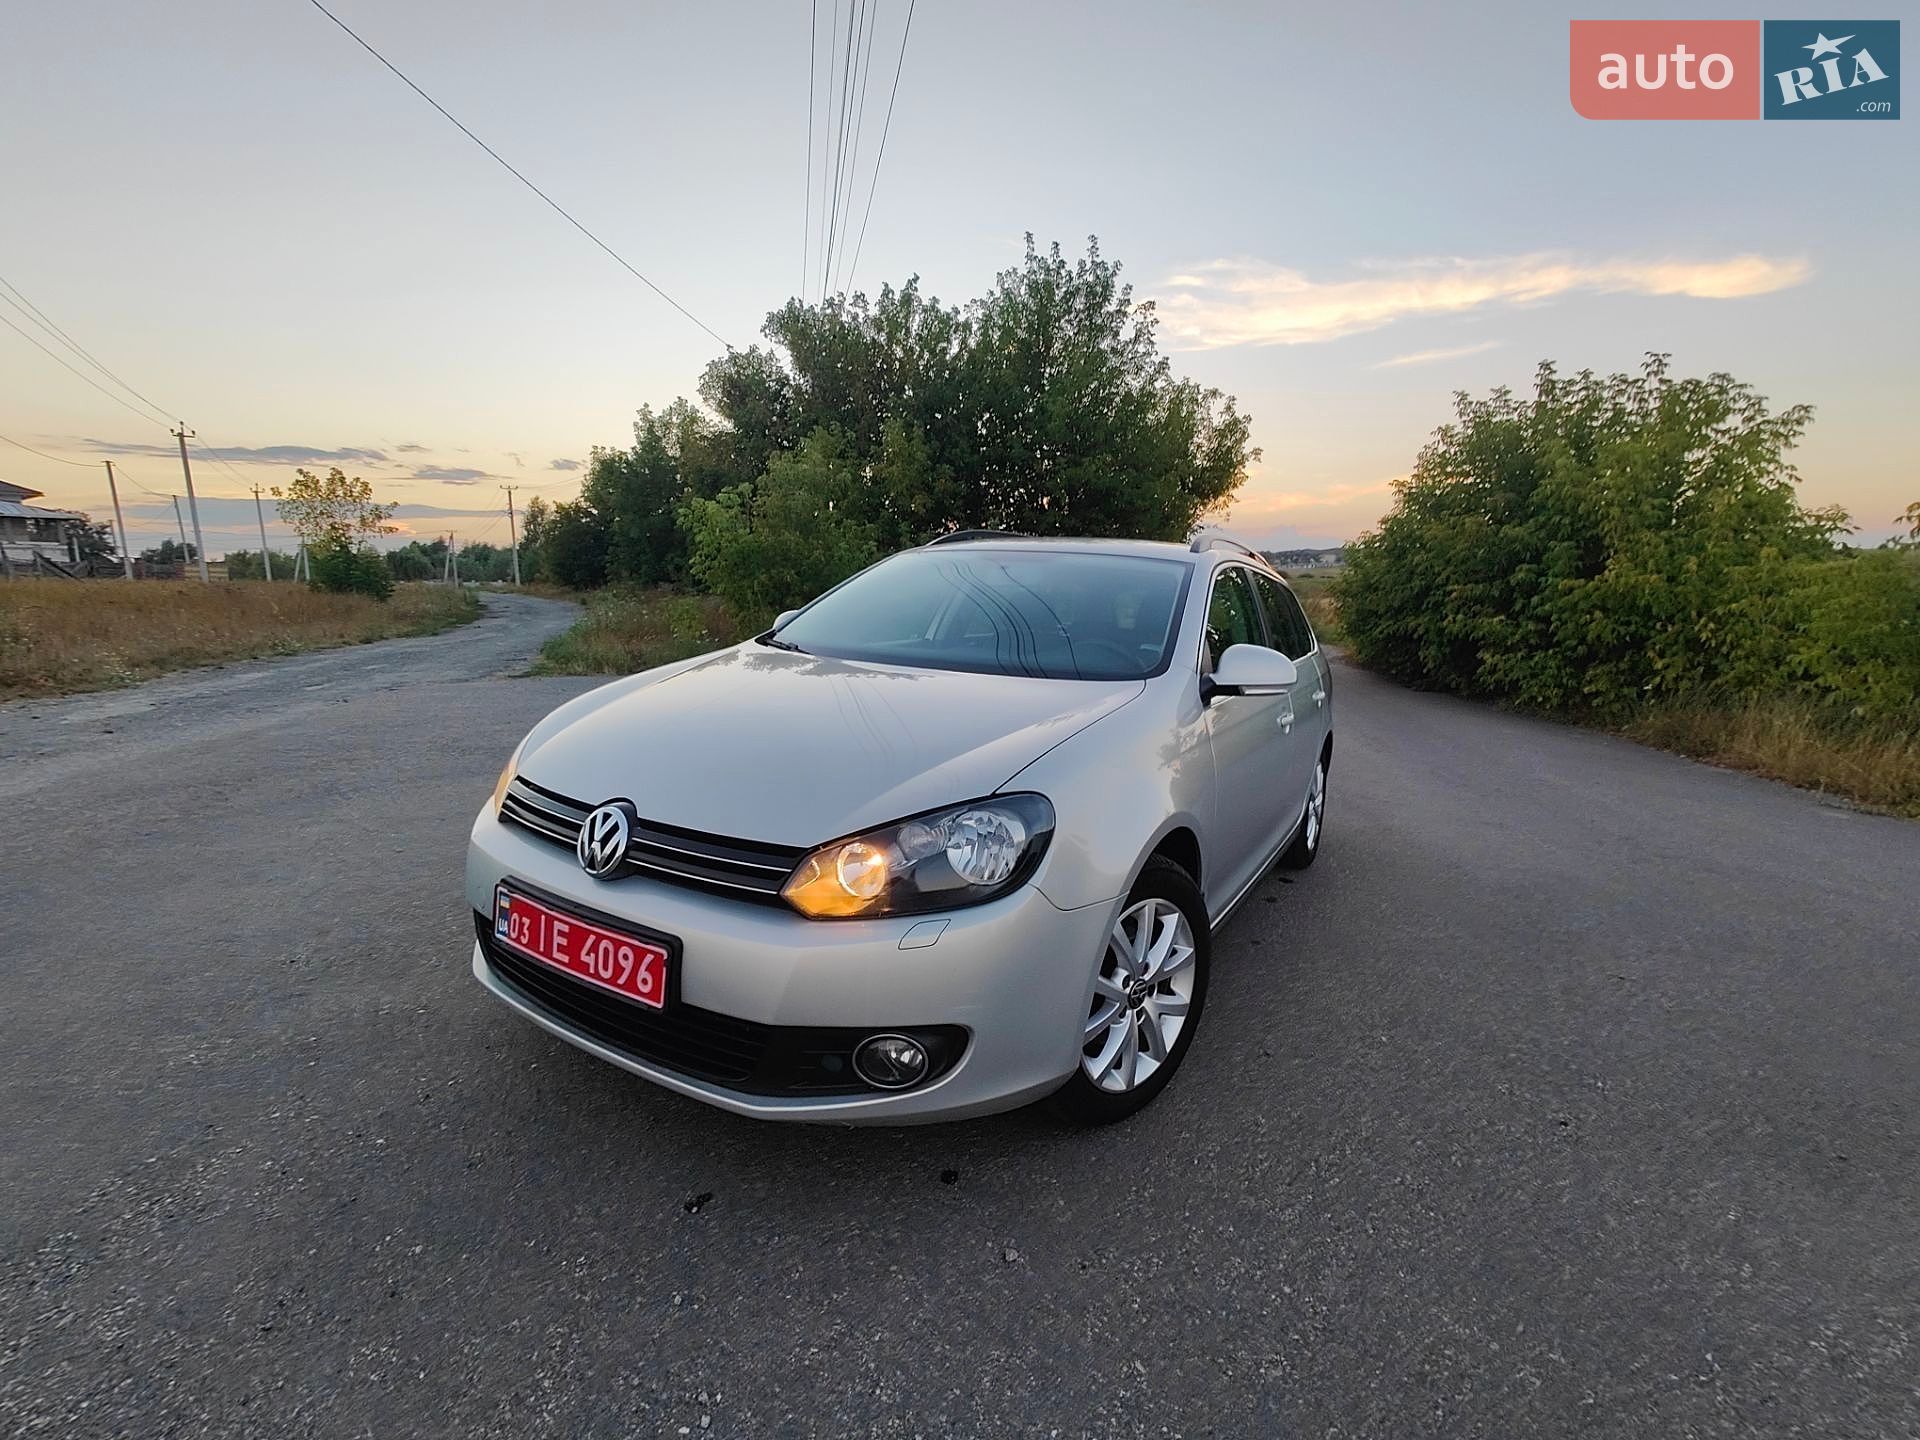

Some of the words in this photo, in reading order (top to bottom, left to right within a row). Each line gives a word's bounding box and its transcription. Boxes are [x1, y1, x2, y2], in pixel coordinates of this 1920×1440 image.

[498, 917, 509, 935] UA
[510, 912, 531, 945] 03
[539, 914, 570, 964] IE
[580, 934, 654, 994] 4096
